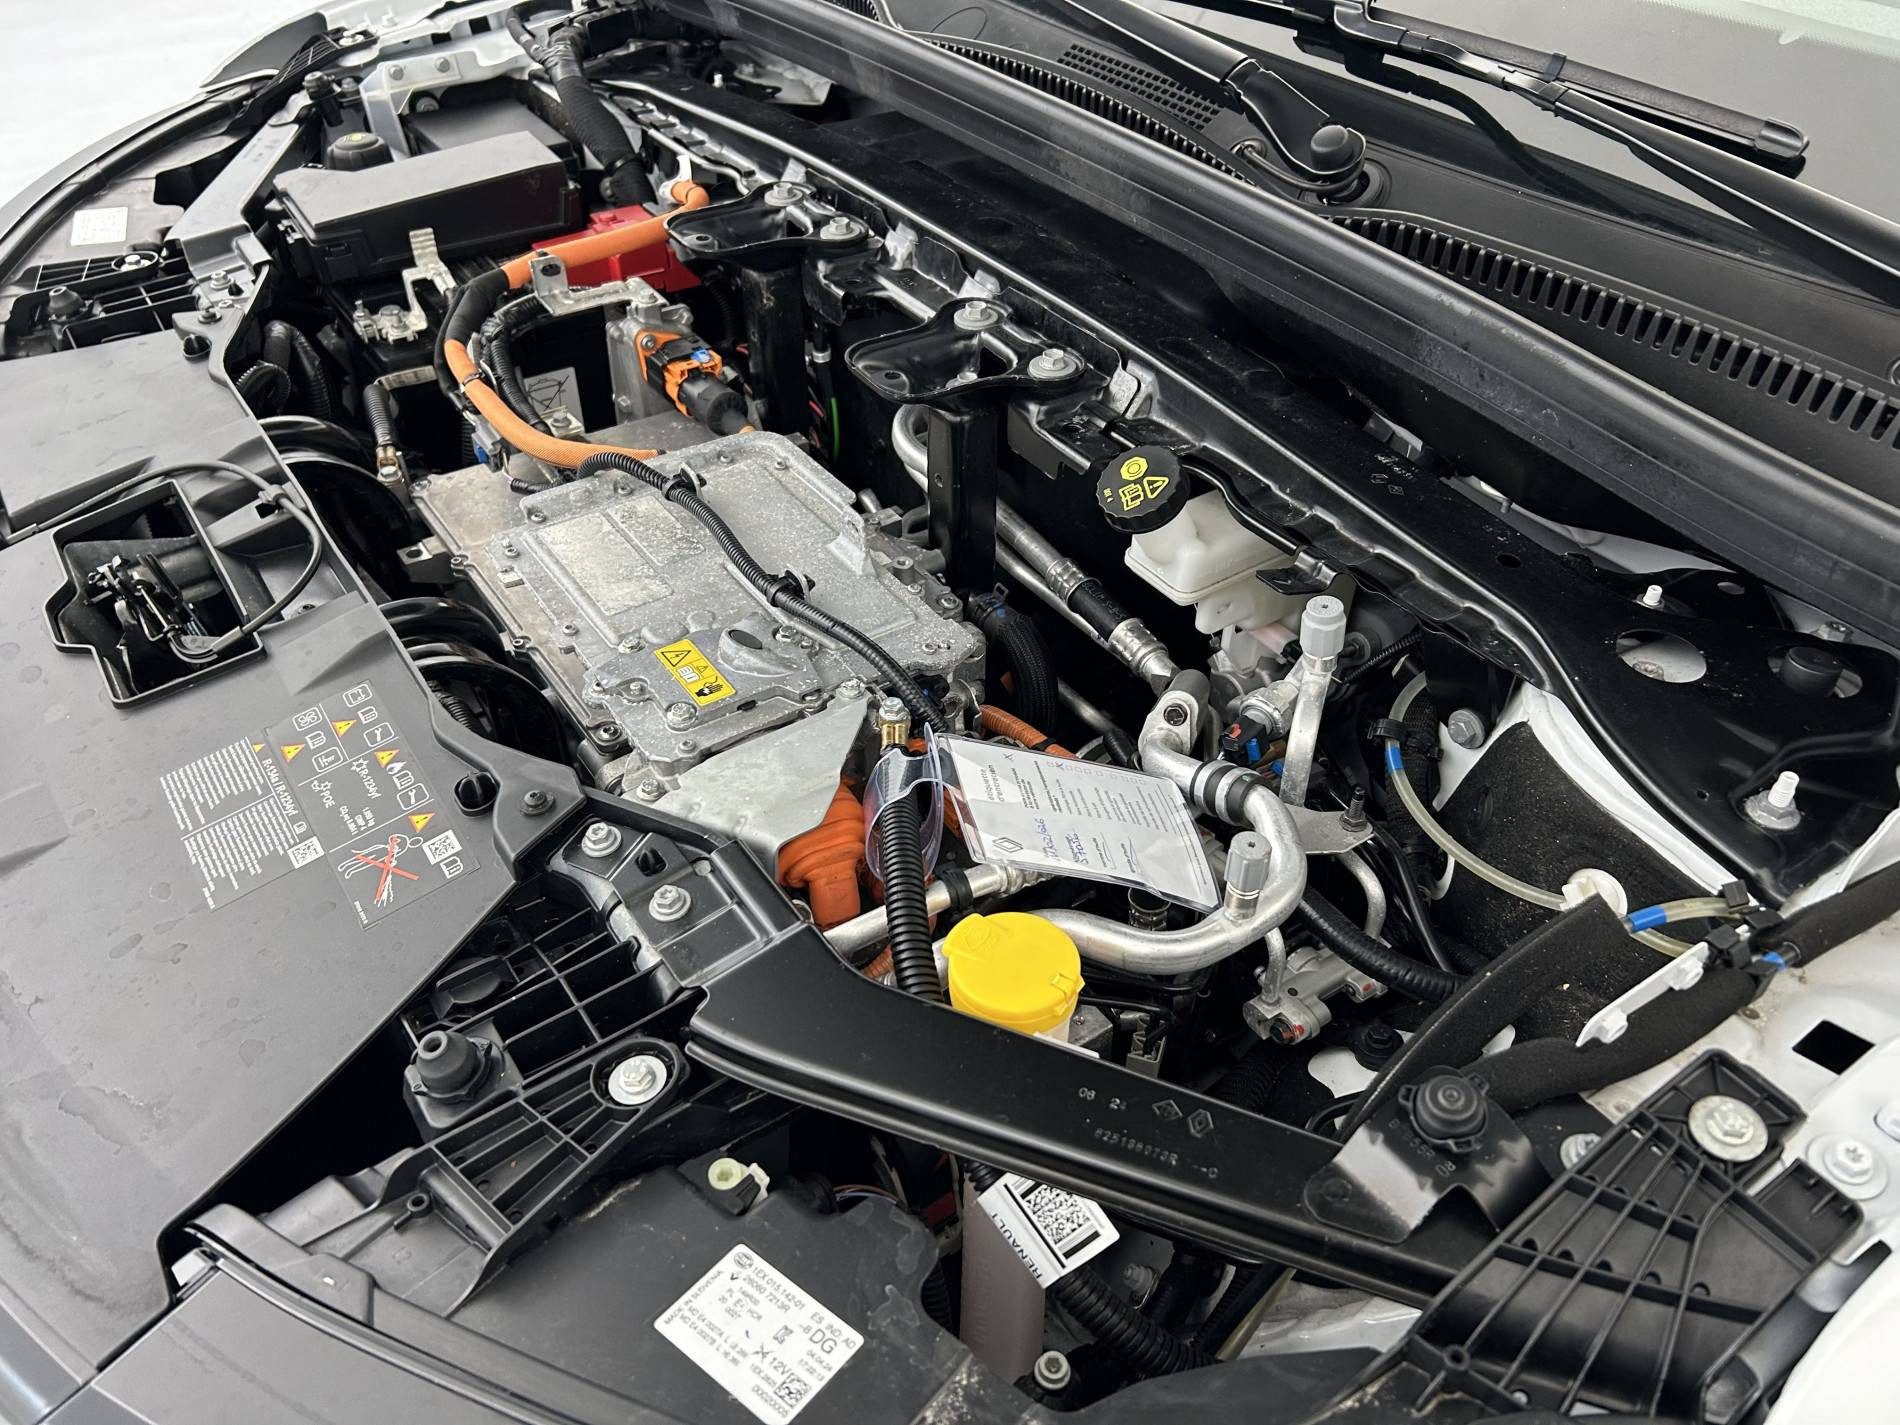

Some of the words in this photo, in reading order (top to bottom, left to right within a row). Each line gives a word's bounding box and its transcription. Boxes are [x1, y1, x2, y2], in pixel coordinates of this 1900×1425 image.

[261, 757, 281, 783] R-134a
[272, 783, 298, 818] R-1234yf
[358, 768, 382, 799] R-1234yf
[981, 768, 996, 800] étiquette
[319, 789, 335, 809] POE
[808, 1326, 839, 1356] DG
[767, 1355, 792, 1378] 12V
